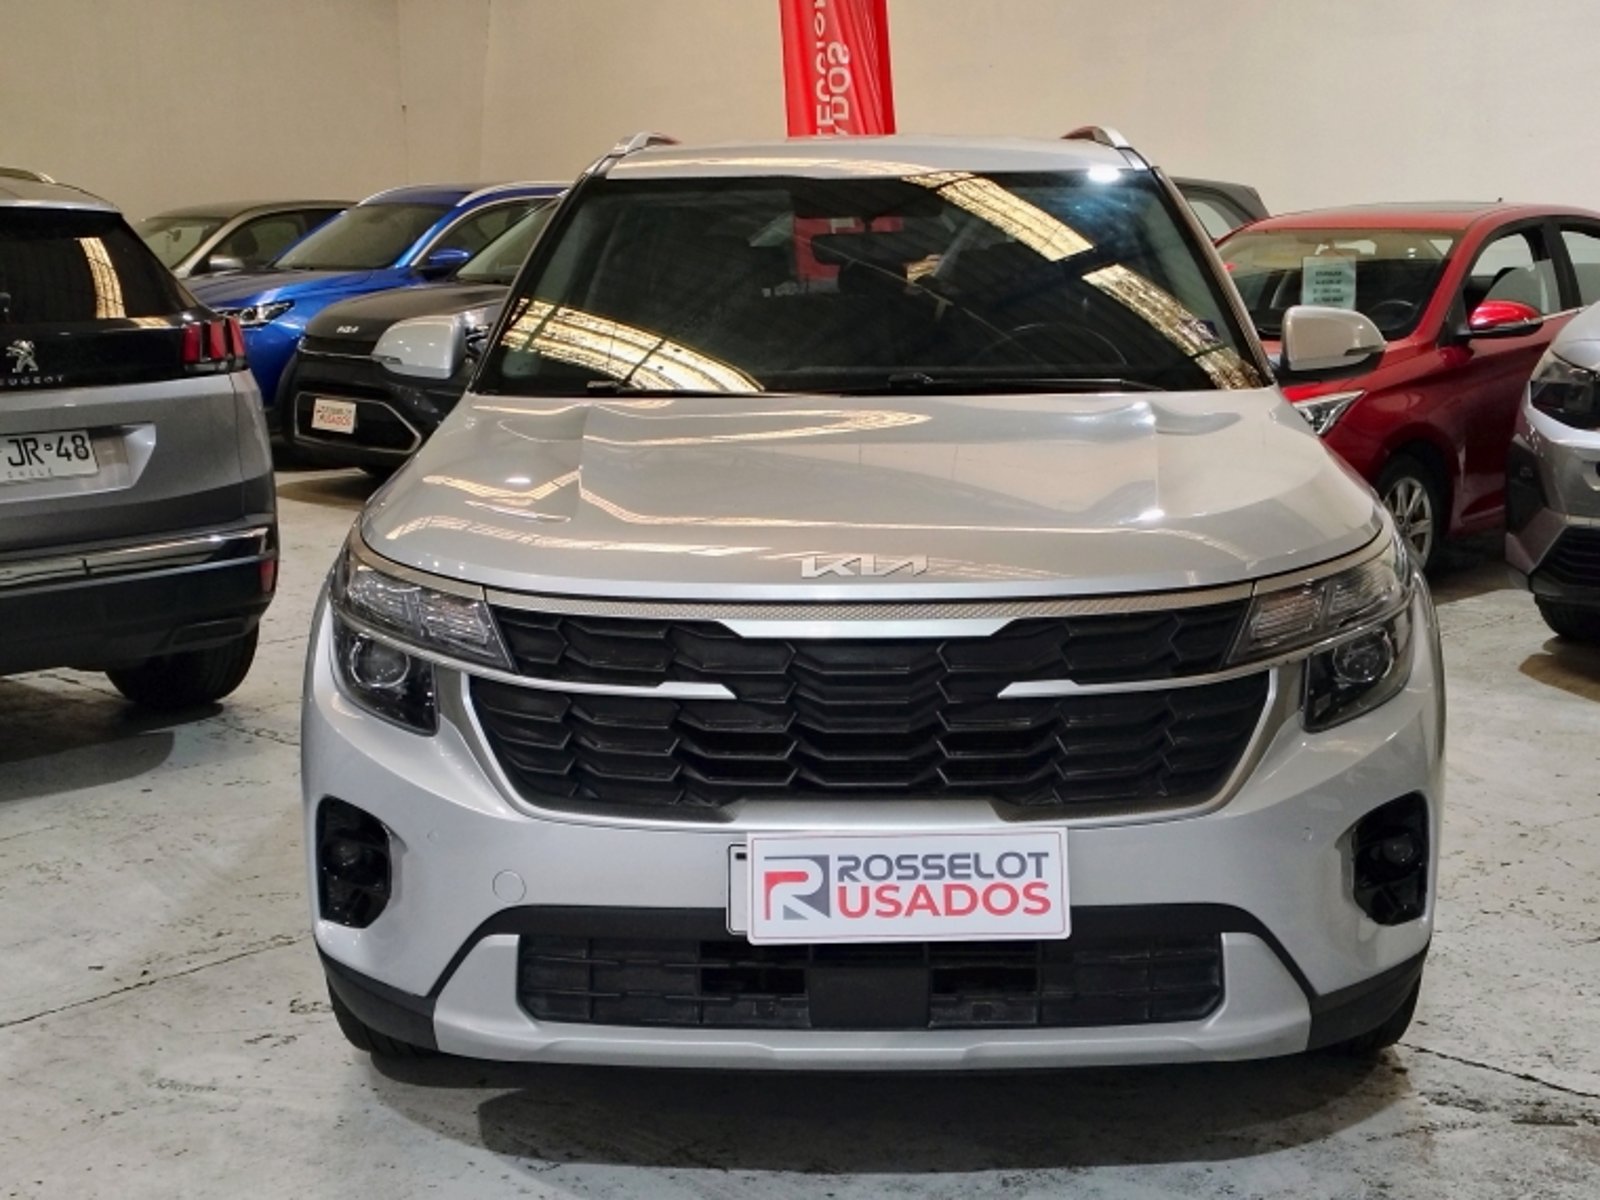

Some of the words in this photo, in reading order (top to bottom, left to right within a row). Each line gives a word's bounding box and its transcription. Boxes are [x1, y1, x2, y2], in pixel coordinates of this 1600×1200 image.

[801, 553, 928, 579] KIA
[837, 851, 1050, 883] ROSSELOT
[837, 881, 1052, 919] USADOS
